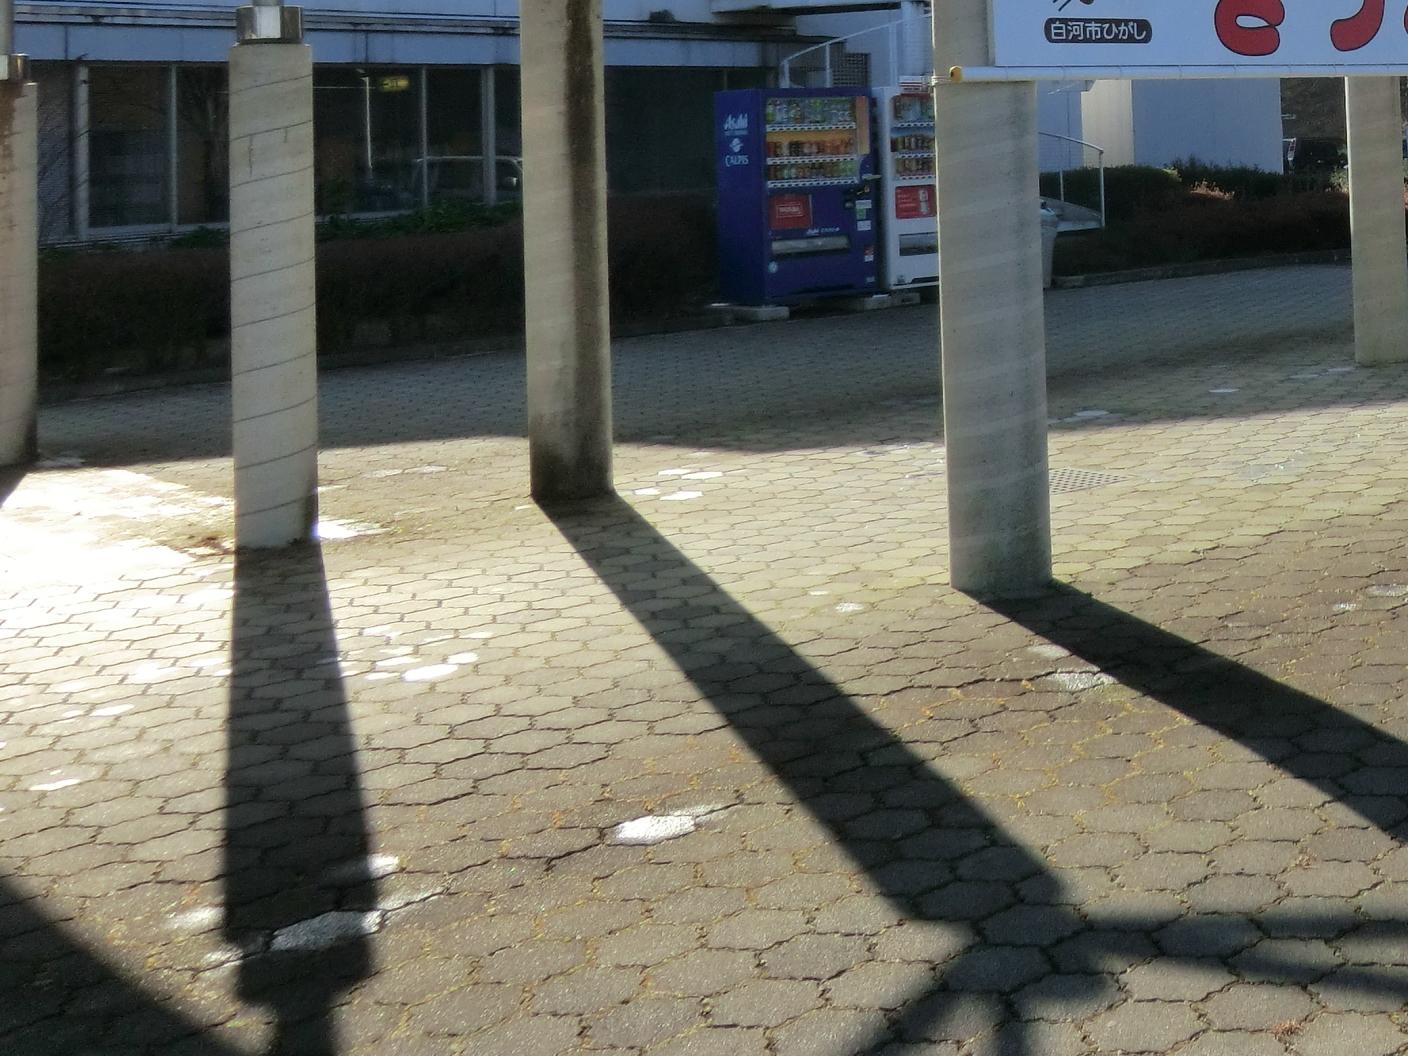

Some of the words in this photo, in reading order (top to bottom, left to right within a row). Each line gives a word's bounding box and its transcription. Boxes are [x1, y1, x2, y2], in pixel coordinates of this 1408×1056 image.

[1050, 19, 1147, 42] 白河市ひがし
